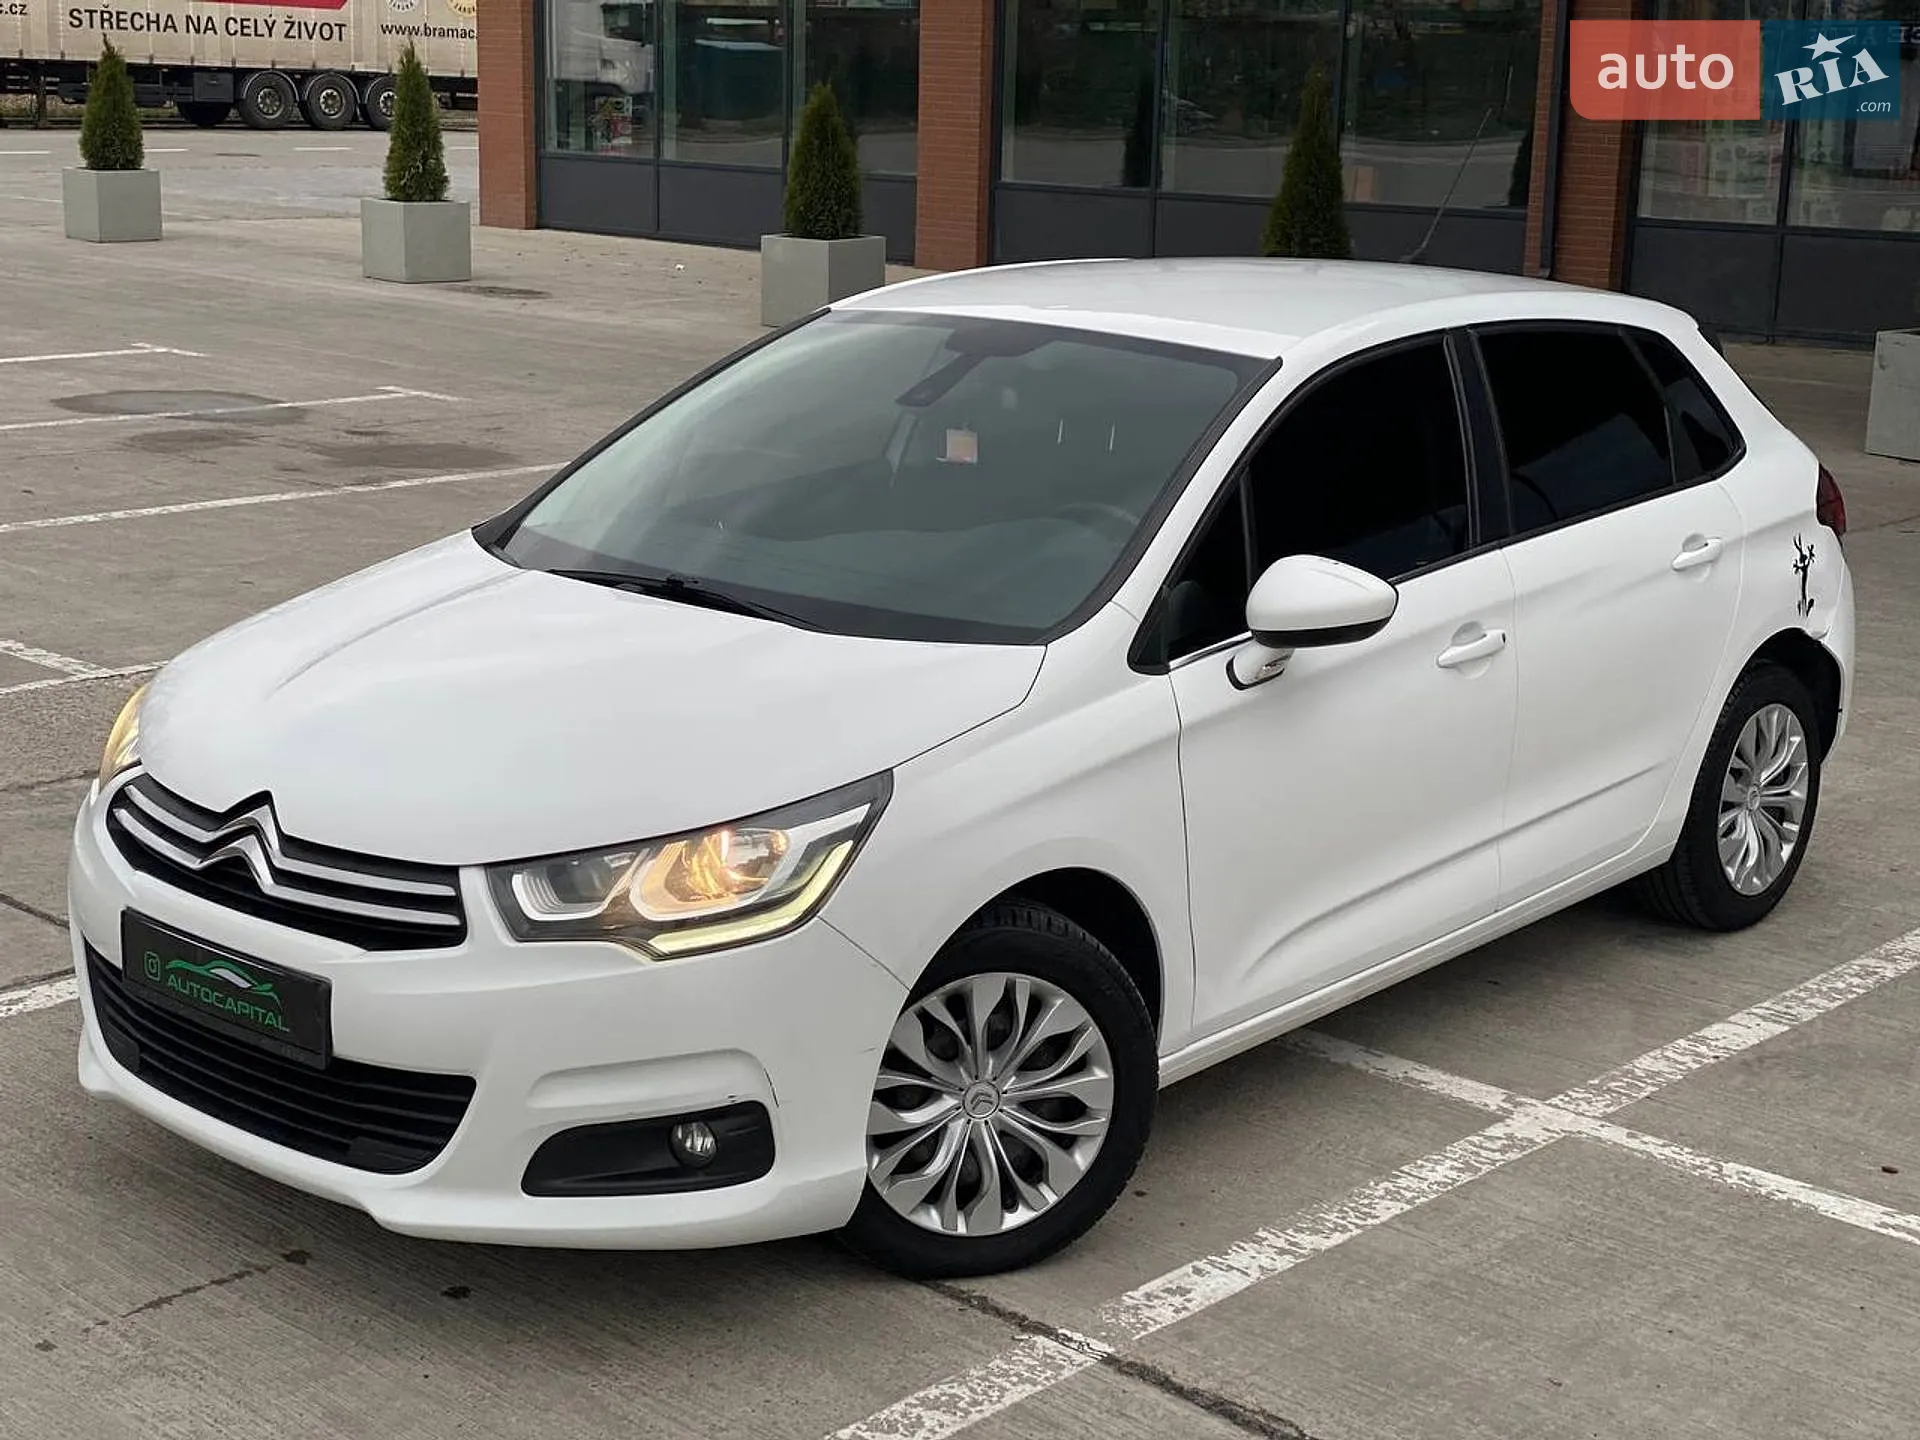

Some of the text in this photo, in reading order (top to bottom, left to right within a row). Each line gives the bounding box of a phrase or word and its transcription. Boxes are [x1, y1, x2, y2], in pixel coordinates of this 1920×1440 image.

[68, 4, 347, 42] STŘECHA NA CELÝ ŽIVOT
[166, 974, 290, 1032] AUTOCAPITAL
